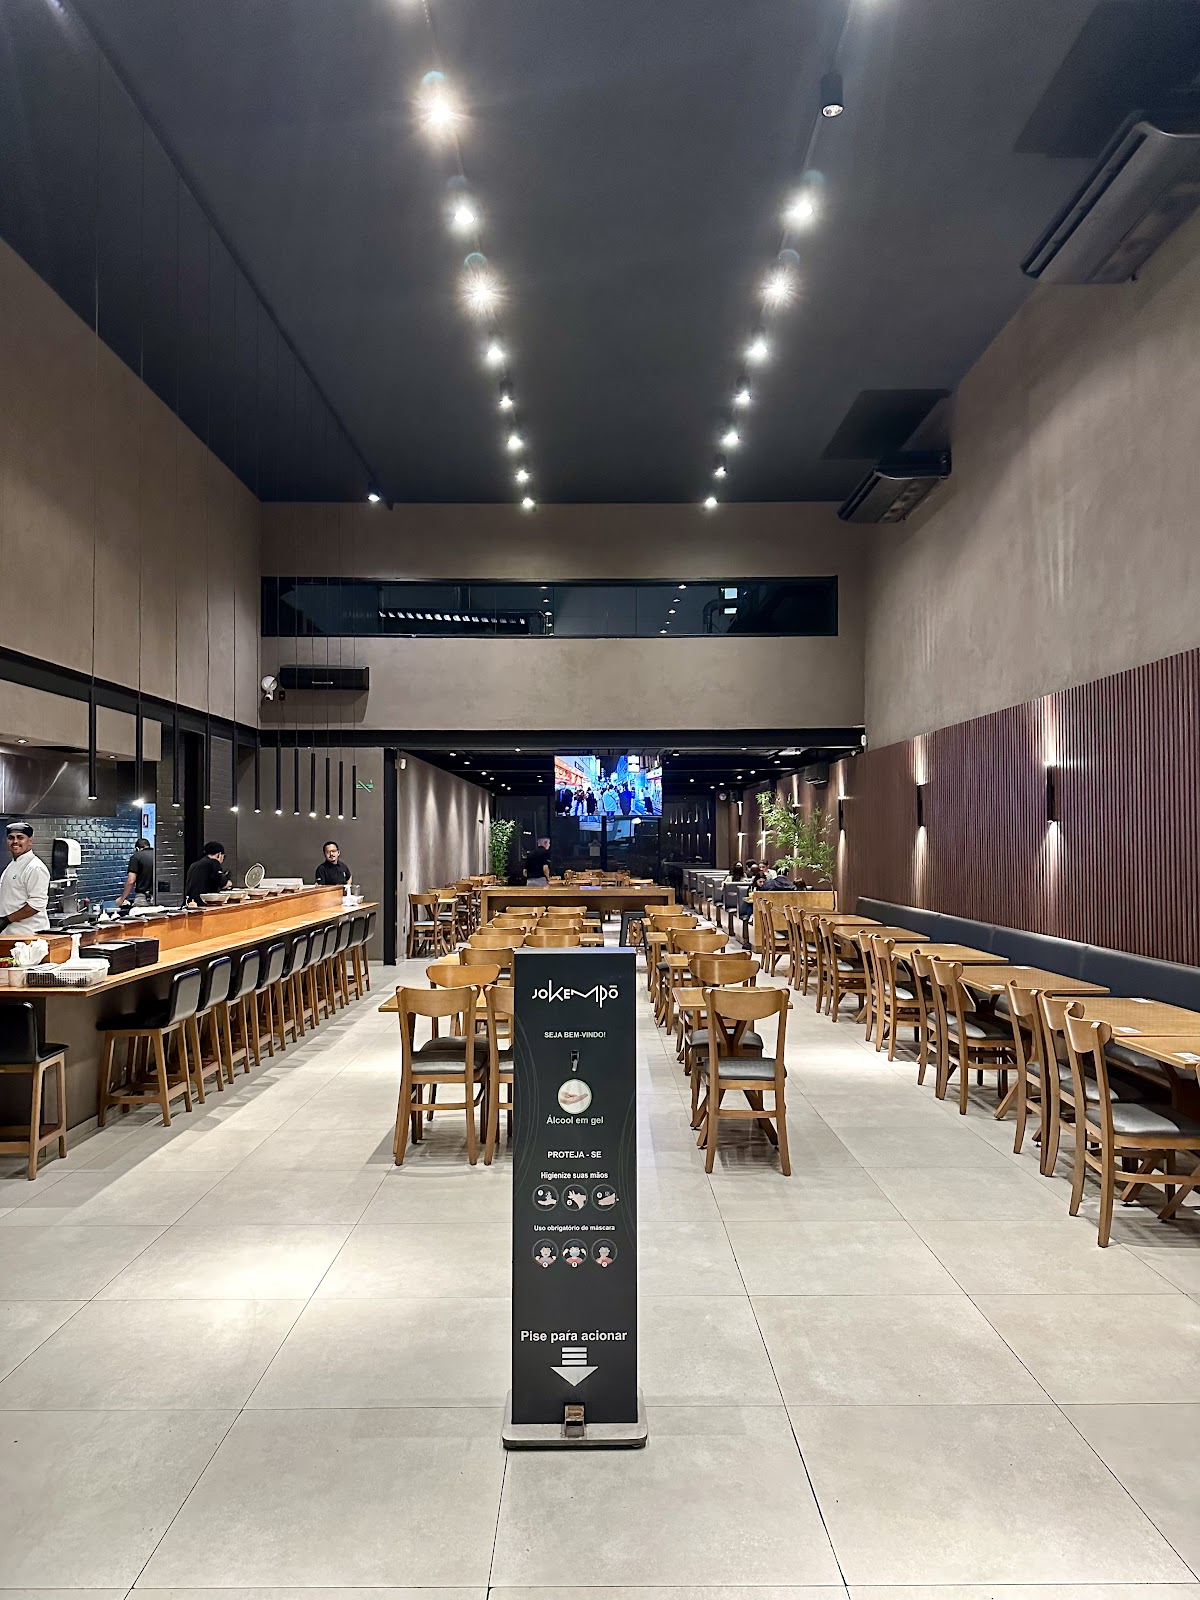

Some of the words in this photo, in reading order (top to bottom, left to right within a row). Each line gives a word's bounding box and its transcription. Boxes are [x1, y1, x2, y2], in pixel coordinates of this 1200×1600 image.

[544, 1031, 562, 1039] SEJA
[564, 1031, 606, 1039] BEM-VINDO!
[547, 1114, 574, 1125] Álcool
[575, 1117, 589, 1125] em
[590, 1116, 604, 1126] gel
[540, 1171, 571, 1180] Higienize
[590, 1171, 608, 1179] mãos
[547, 1224, 580, 1232] obrigatório
[520, 1330, 547, 1341] Pise
[550, 1331, 578, 1343] para
[581, 1330, 627, 1341] acionar
